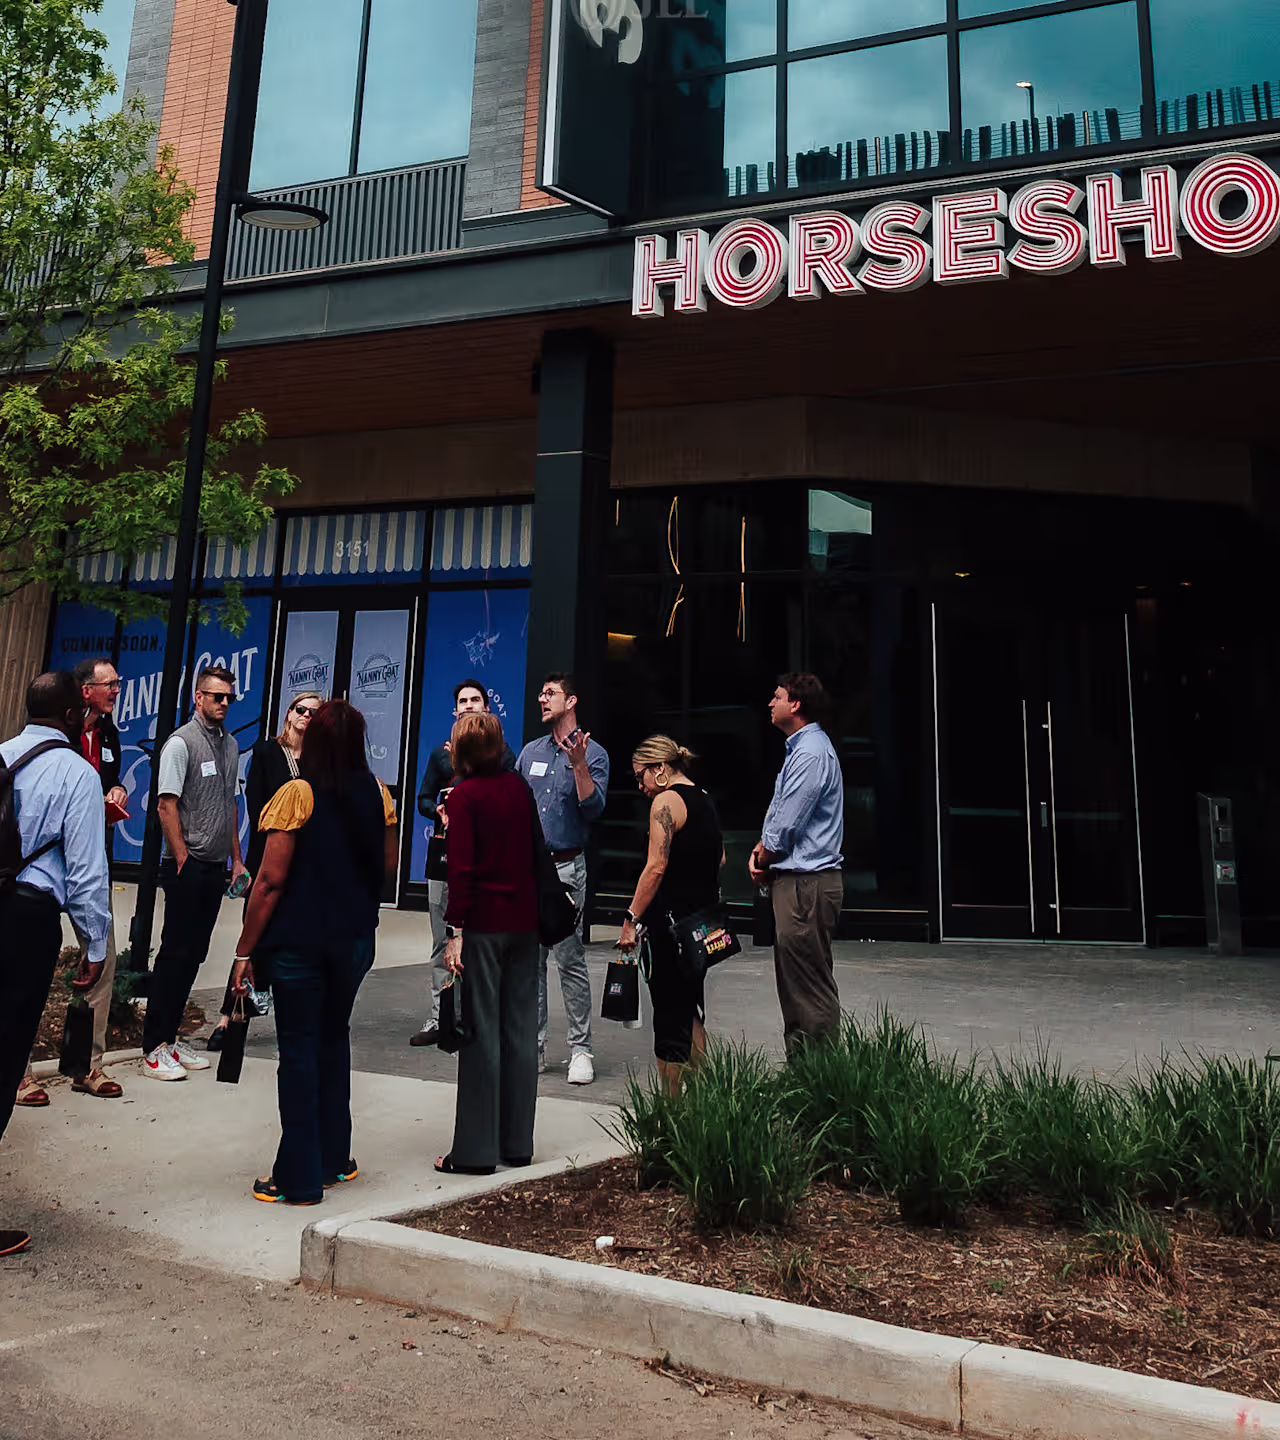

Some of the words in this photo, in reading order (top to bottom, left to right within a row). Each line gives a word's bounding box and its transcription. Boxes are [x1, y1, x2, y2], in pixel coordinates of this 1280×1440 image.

[335, 540, 369, 557] 3151
[287, 670, 311, 686] NANNY
[357, 668, 381, 686] NANNY
